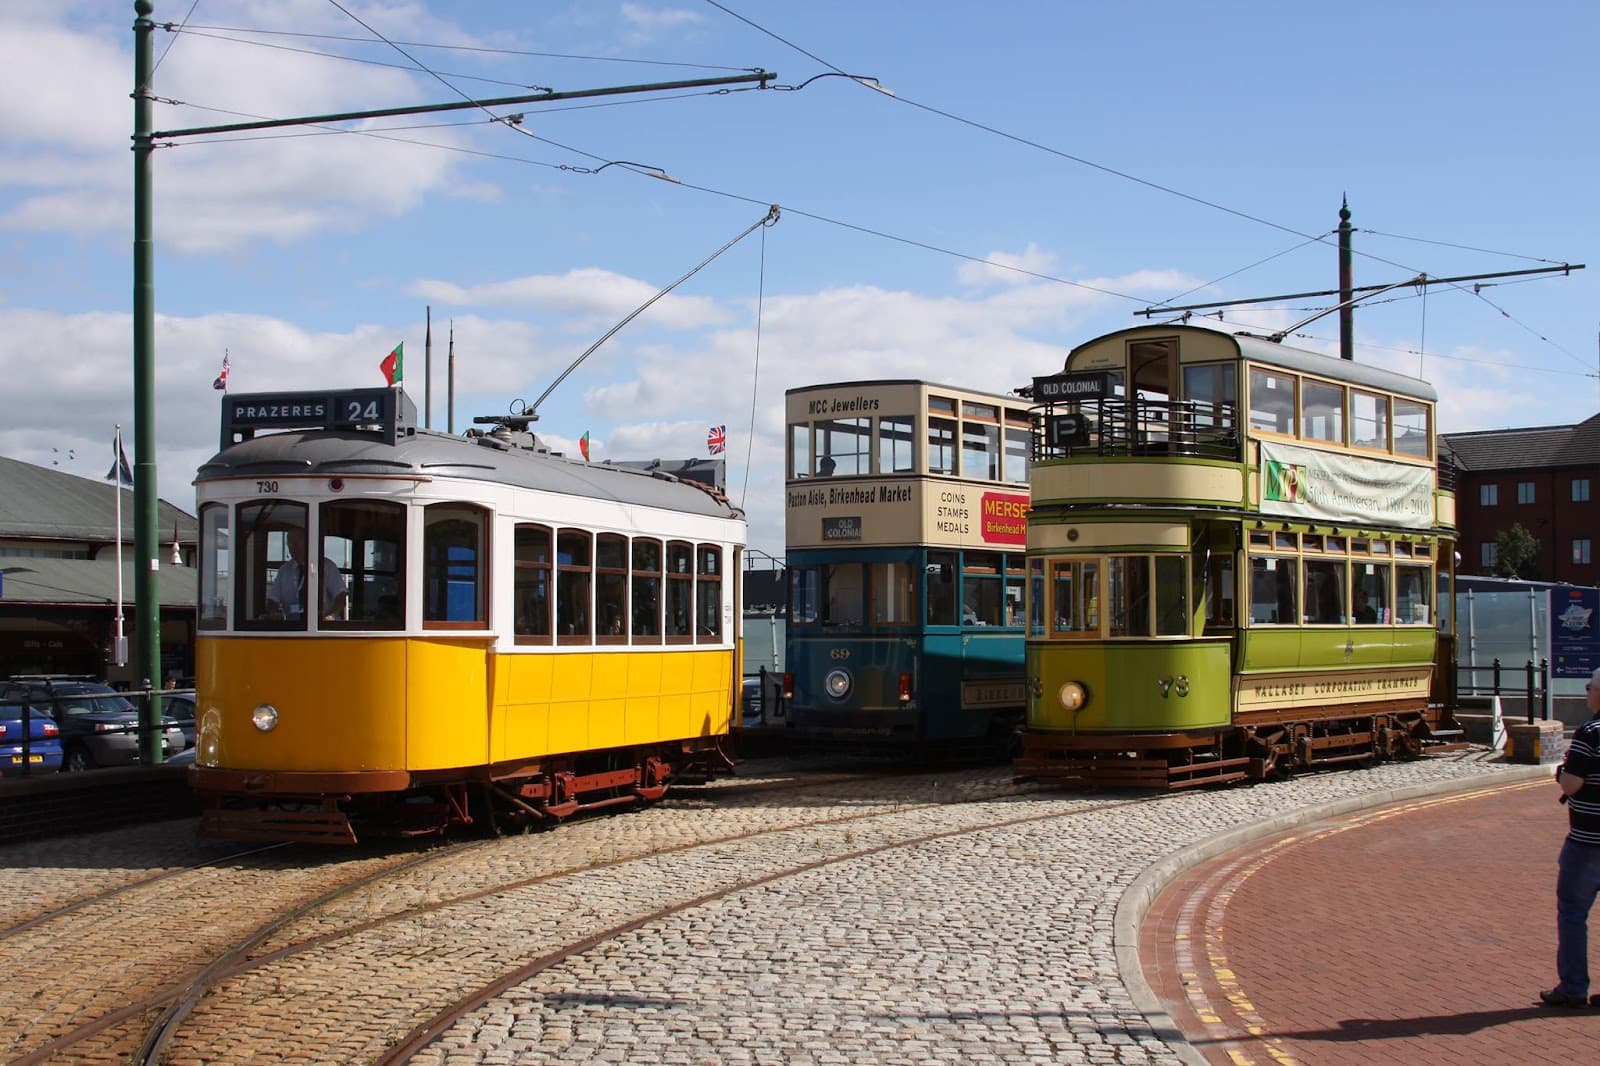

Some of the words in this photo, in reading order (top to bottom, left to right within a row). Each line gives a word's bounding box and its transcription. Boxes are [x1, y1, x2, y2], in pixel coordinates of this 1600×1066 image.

[1043, 383, 1059, 395] OLD
[1061, 381, 1100, 394] COLONIAL
[235, 404, 325, 419] PRAZERES
[348, 400, 380, 422] 24
[808, 399, 828, 415] MCC
[831, 396, 880, 413] Jewellers
[256, 481, 279, 494] 730
[808, 488, 827, 508] Aisle,
[829, 486, 876, 505] Birkenhead
[880, 484, 912, 502] Market
[941, 492, 966, 504] COINS
[937, 506, 969, 519] STAMPS
[985, 499, 1030, 518] MERSE
[937, 521, 969, 534] MEDALS
[1158, 675, 1189, 699] 78
[1254, 683, 1306, 698] WALLASEY
[1314, 679, 1373, 695] CORPORATION
[1377, 676, 1419, 690] TRAMWAYS
